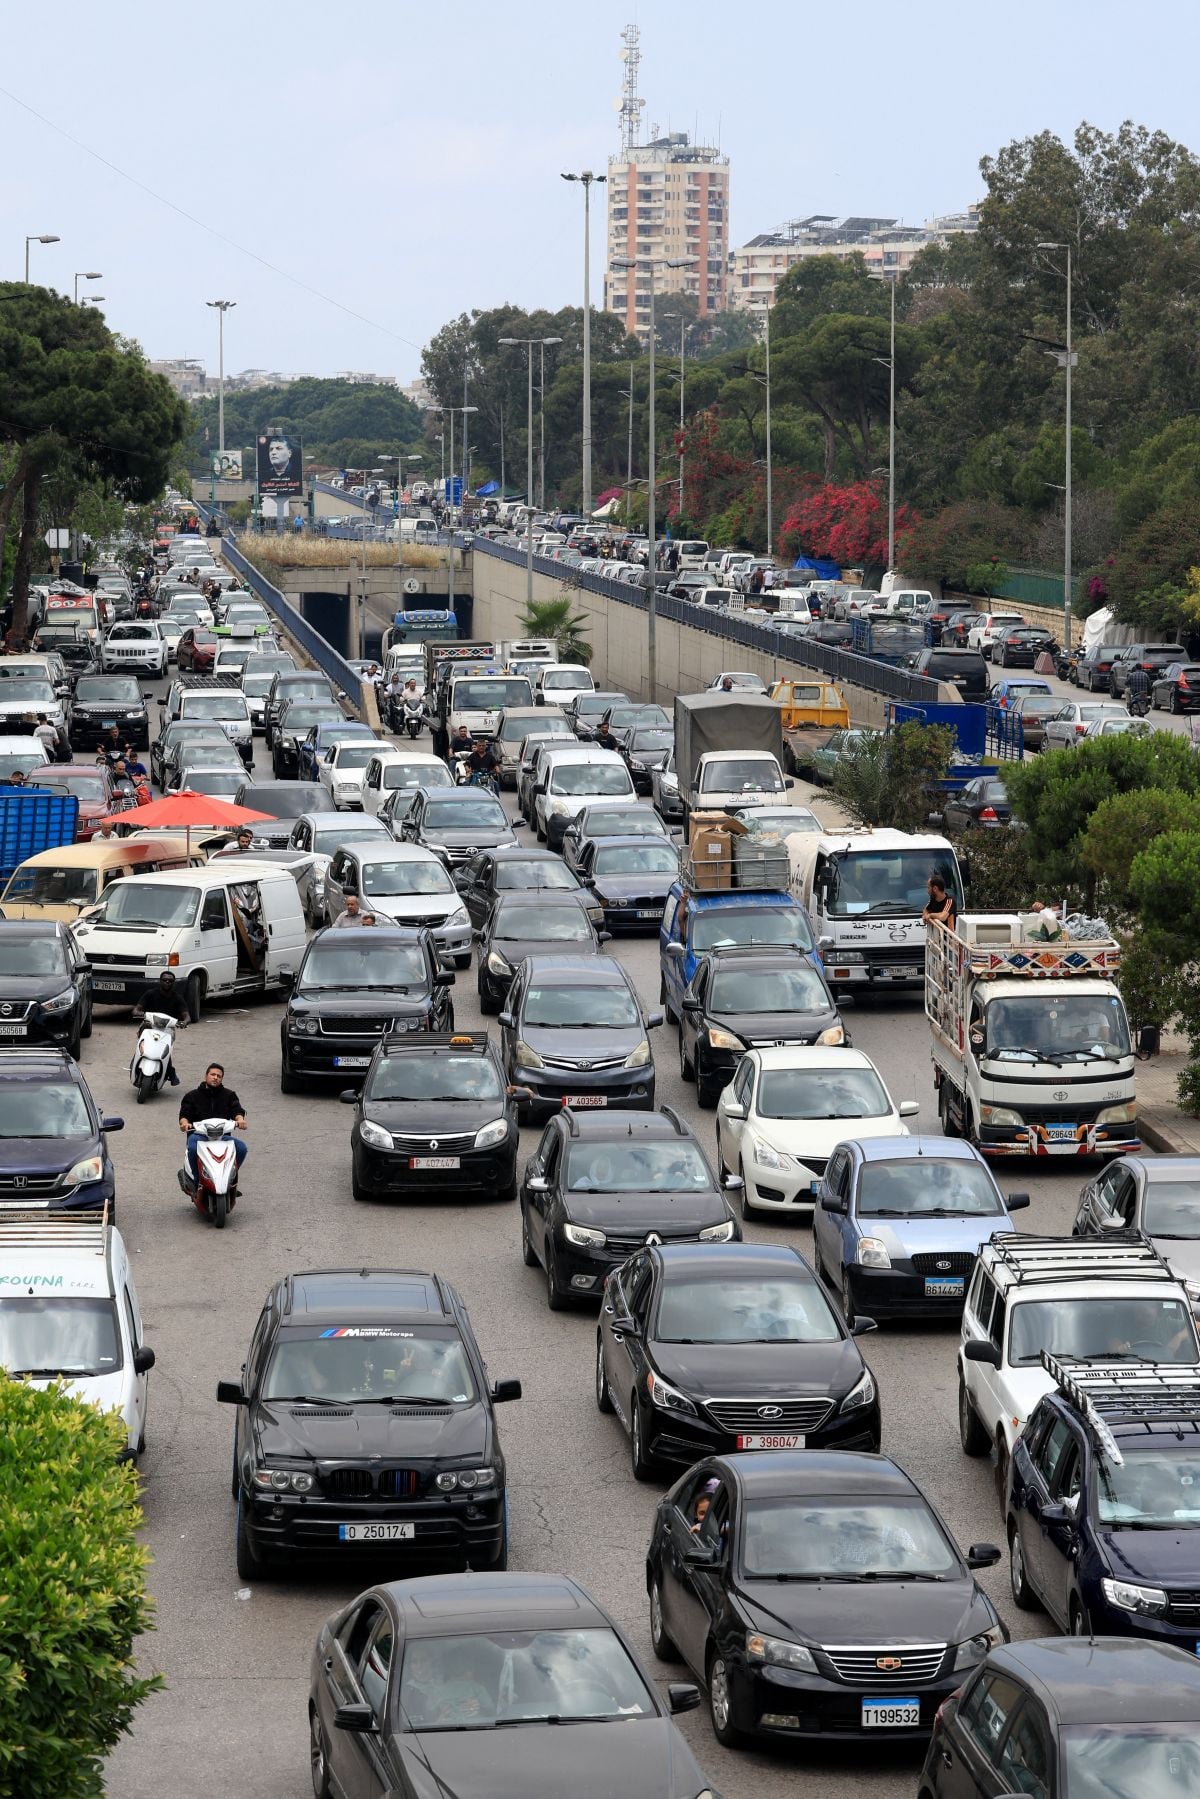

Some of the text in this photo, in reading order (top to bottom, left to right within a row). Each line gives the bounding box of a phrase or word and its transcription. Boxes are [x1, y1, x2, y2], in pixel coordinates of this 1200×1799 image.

[568, 1097, 573, 1105] P
[416, 1159, 420, 1167] P
[926, 1285, 963, 1295] B614475
[746, 1436, 798, 1448] P 396047
[363, 1526, 406, 1538] 250174
[864, 1709, 918, 1724] T199532
